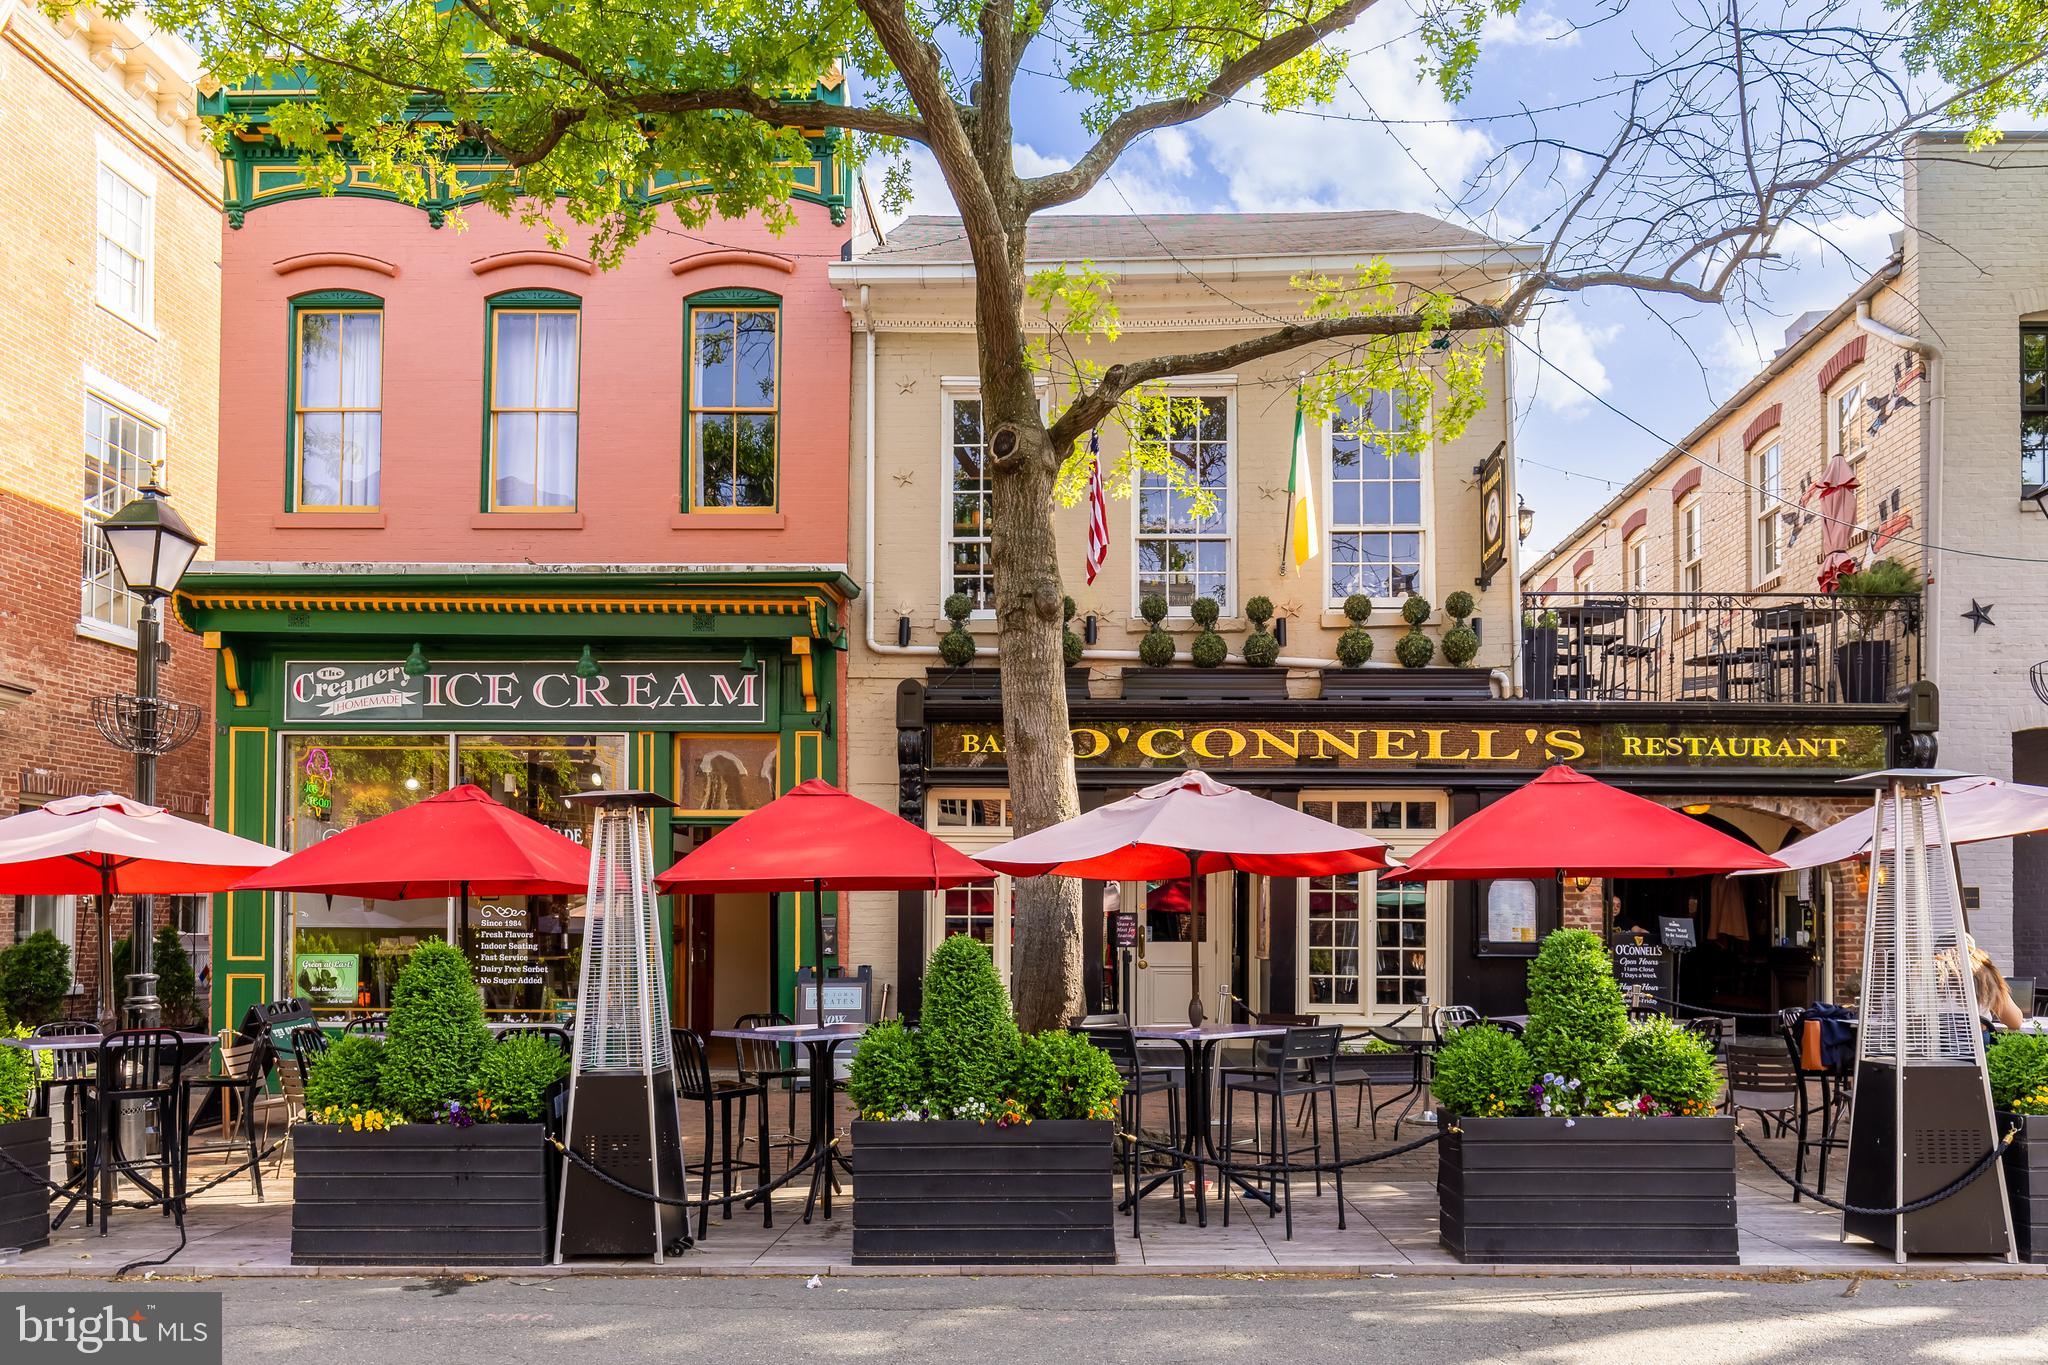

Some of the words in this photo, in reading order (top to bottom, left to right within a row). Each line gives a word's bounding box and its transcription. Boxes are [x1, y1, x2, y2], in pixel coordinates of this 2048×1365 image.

[320, 669, 342, 677] The
[293, 666, 410, 703] Creamery
[423, 672, 522, 709] ICE
[532, 672, 759, 709] CREAM
[336, 694, 400, 713] HOMEMADE
[961, 734, 1007, 754] BA
[1069, 728, 1585, 760] O'CONNELL'S
[1622, 736, 1846, 757] RESTAURANT
[508, 943, 538, 951] Seating
[1615, 944, 1663, 956] O'CONNELL'S
[1619, 957, 1637, 967] Open
[1638, 957, 1659, 966] Hours
[493, 977, 517, 985] Sugar
